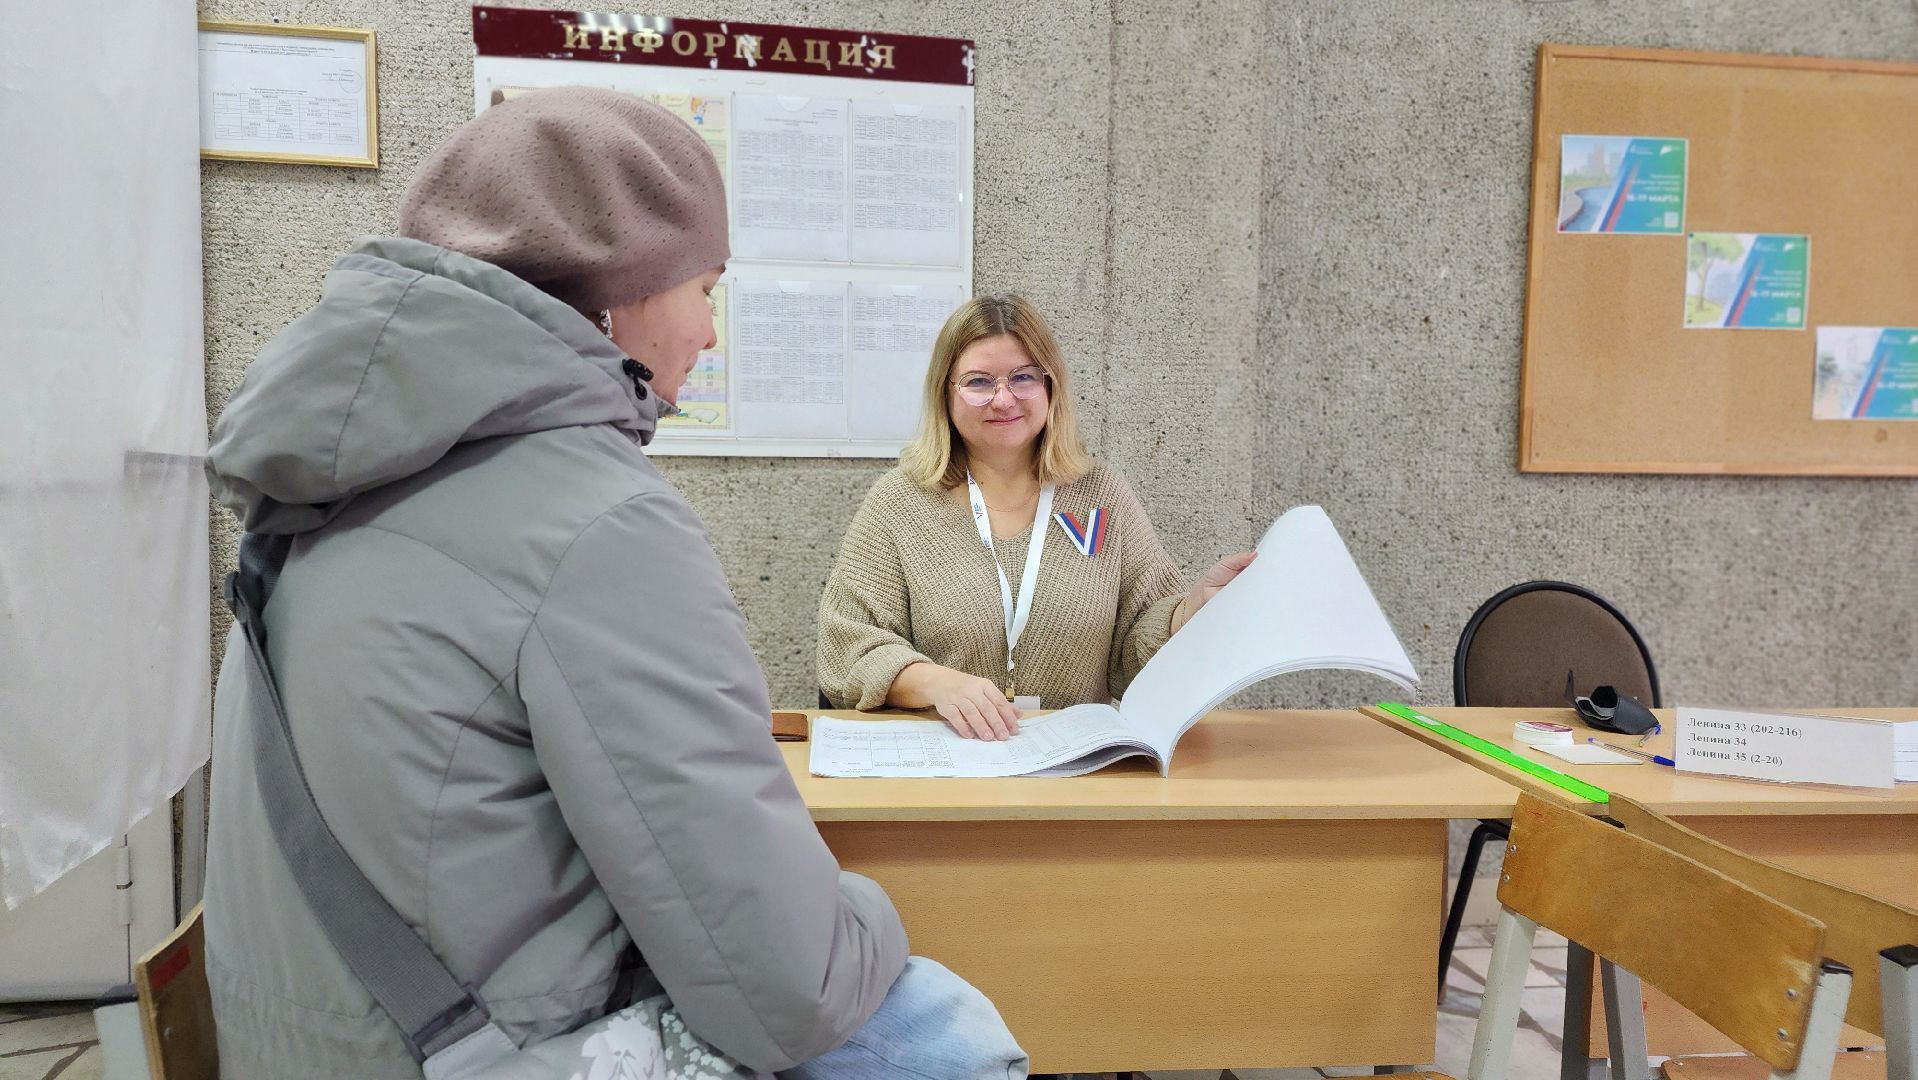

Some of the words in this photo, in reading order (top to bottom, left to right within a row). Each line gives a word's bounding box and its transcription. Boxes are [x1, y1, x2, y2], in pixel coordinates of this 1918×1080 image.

[563, 24, 896, 71] ИНФОРМАЦИЯ
[1687, 718, 1731, 730] Ленина
[1733, 723, 1747, 731] 33
[1750, 724, 1802, 739] (202-216)
[1687, 733, 1731, 745] Ленина
[1733, 738, 1747, 747] 34
[1686, 748, 1731, 760] Ленина
[1733, 752, 1747, 761] 35
[1750, 754, 1783, 767] (2-20)
